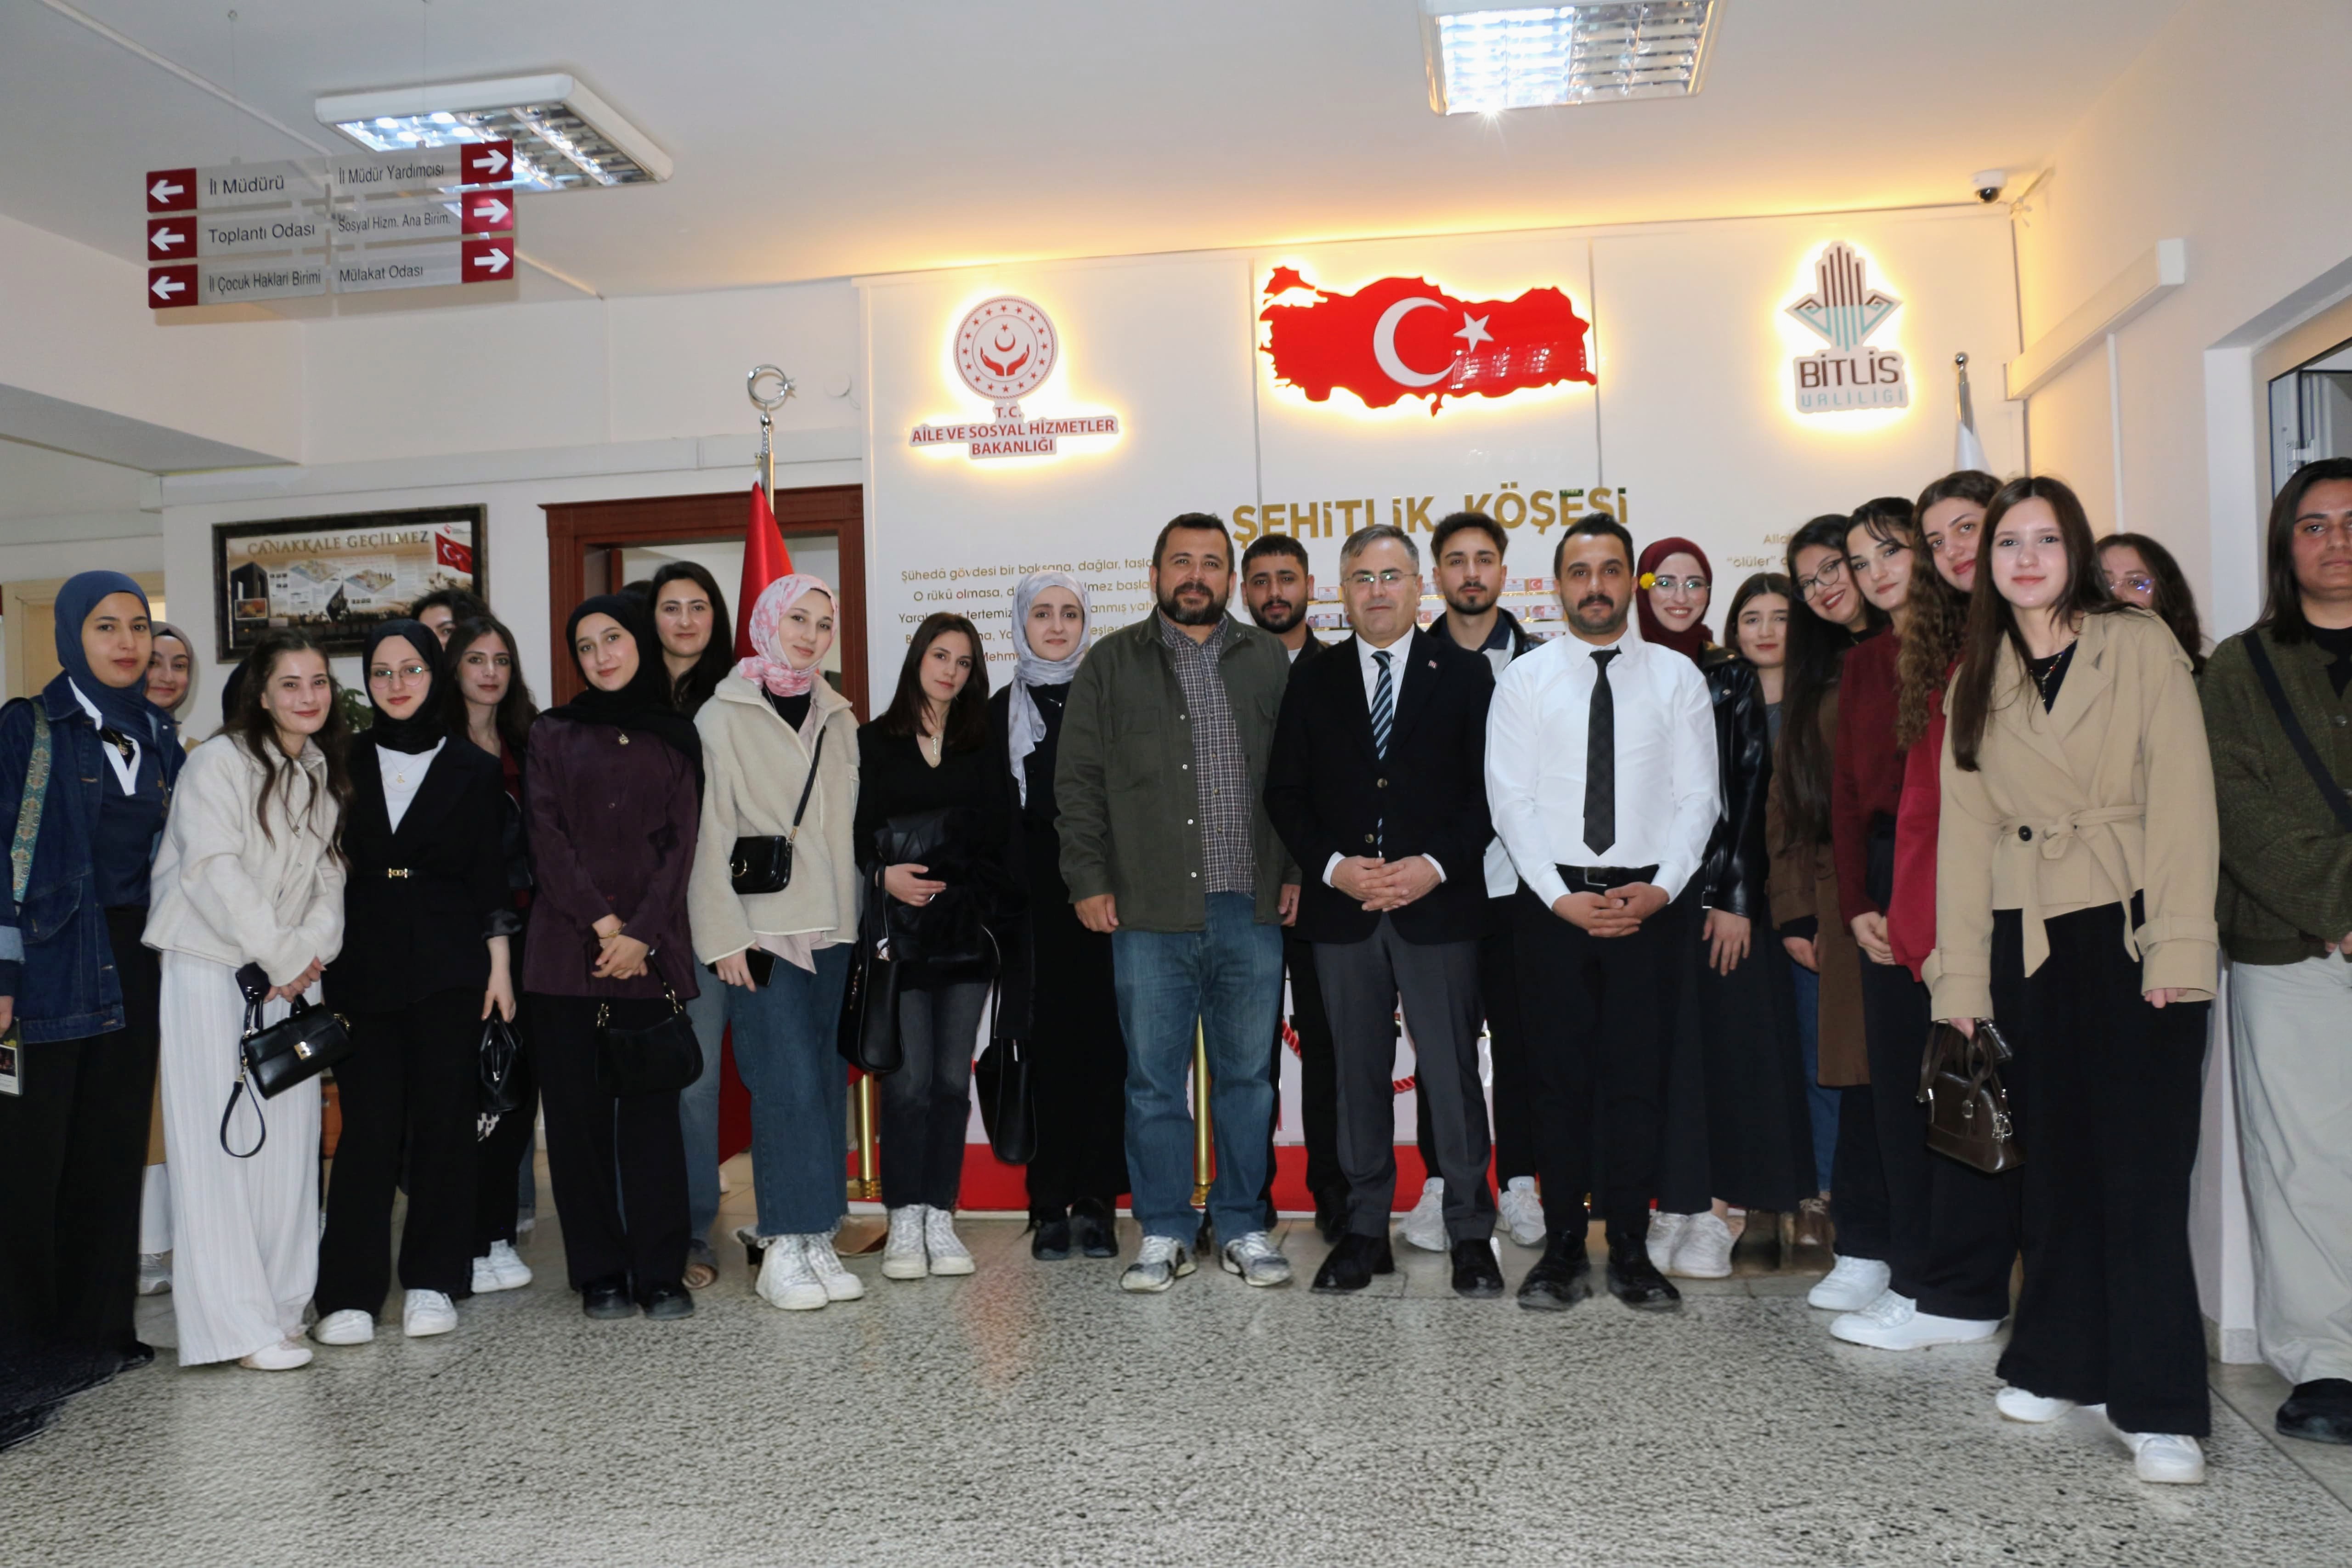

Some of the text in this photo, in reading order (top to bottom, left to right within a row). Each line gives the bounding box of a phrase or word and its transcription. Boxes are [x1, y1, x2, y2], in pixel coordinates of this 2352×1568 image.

[349, 167, 383, 183] Müdür
[387, 164, 444, 180] Yardımcısı
[223, 175, 284, 194] Müdürü
[339, 212, 451, 233] Sosyal Hizm. Ana Birim.
[209, 223, 315, 245] Toplantı Odası
[218, 274, 250, 294] Çocuk
[292, 269, 321, 286] Birimi
[340, 265, 423, 283] Mülakat Odası
[1800, 351, 1900, 388] BİTLİS
[912, 419, 1115, 442] AİLE VE SOSYAL HİZMETLER
[972, 436, 1053, 456] BAKANLIĞI
[1464, 481, 1628, 535] KÖŞESİ
[347, 530, 429, 549] GEÇİLMEZ
[1763, 534, 1792, 544] Alla
[901, 568, 946, 584] Şühedâ
[950, 566, 996, 581] gövdesi
[1000, 565, 1014, 575] bir
[1078, 559, 1120, 573] dağlar,
[1125, 557, 1153, 570] taşla
[913, 591, 923, 601] O
[956, 588, 1003, 599] olmasa,
[967, 608, 1012, 619] tertemiz
